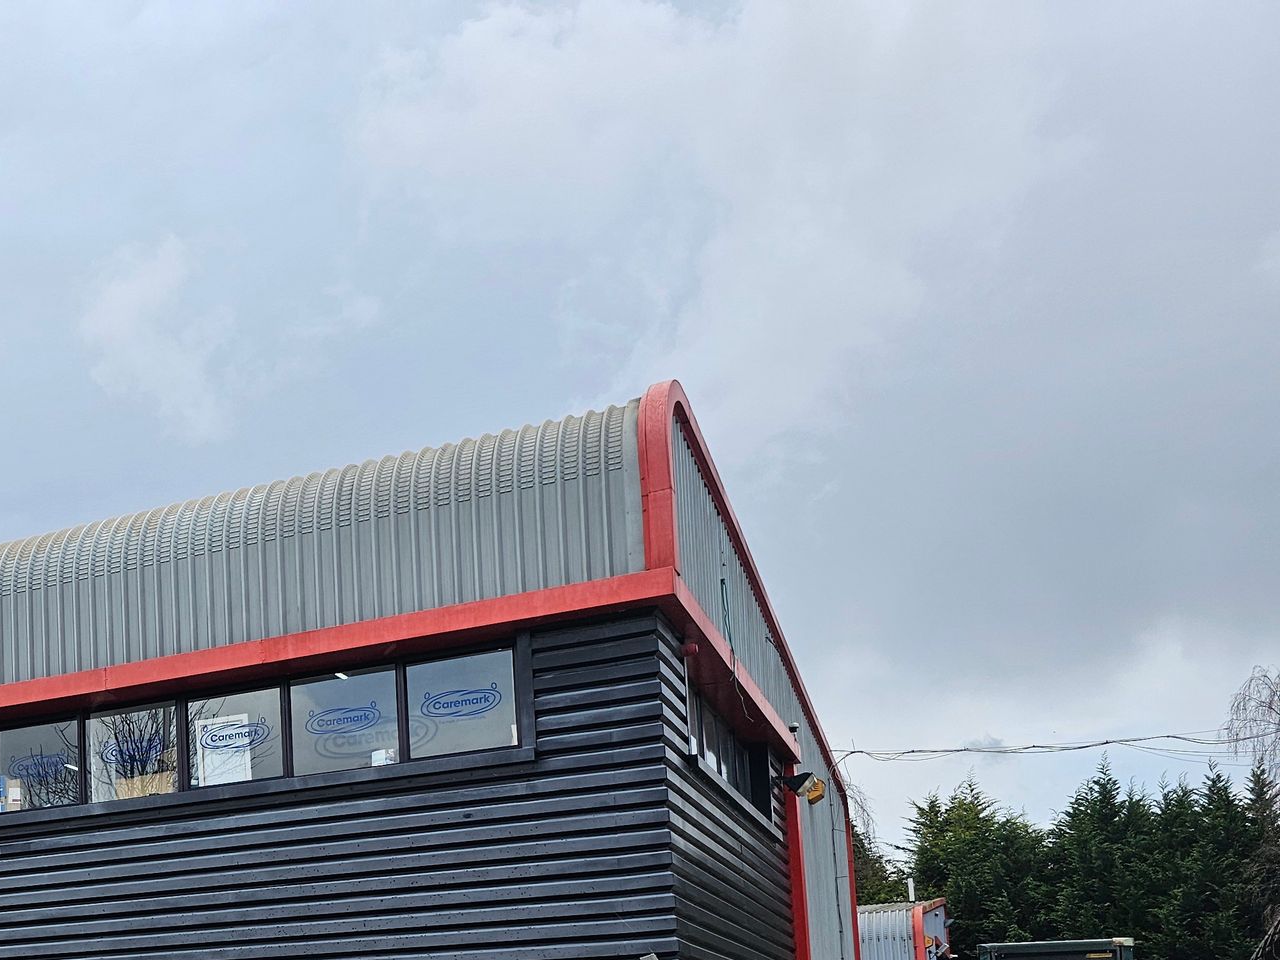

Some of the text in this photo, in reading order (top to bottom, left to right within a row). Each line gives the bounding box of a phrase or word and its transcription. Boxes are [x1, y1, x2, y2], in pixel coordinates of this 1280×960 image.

[433, 694, 491, 710] Caremark
[317, 712, 371, 728] Caremark
[210, 728, 260, 743] Caremark
